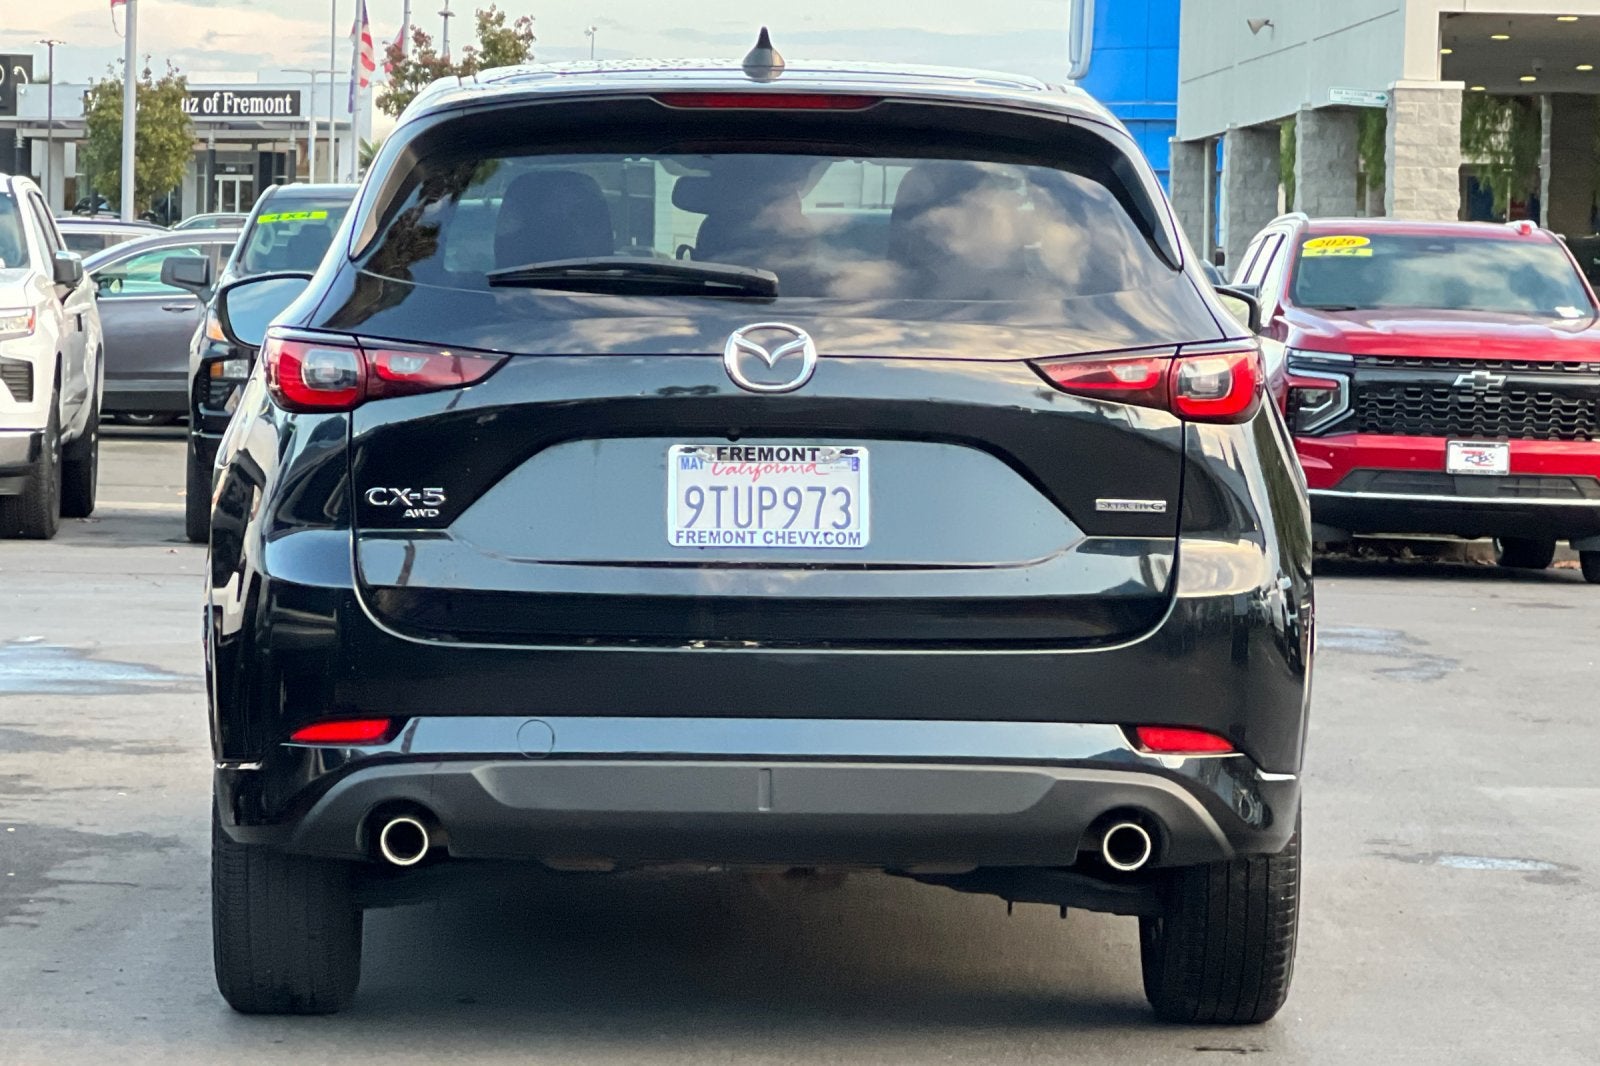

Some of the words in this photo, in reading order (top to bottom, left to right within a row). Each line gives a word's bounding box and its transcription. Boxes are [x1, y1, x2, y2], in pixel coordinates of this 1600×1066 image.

[203, 92, 219, 113] of
[222, 92, 292, 113] Fremont
[716, 447, 820, 461] FREMONT
[681, 458, 704, 470] MAY
[712, 463, 829, 482] California
[365, 487, 446, 506] CX-5
[404, 509, 439, 518] AWD
[684, 486, 851, 529] 9TUP973
[675, 530, 757, 544] FREMONT
[763, 531, 861, 545] CHEVY.COM
